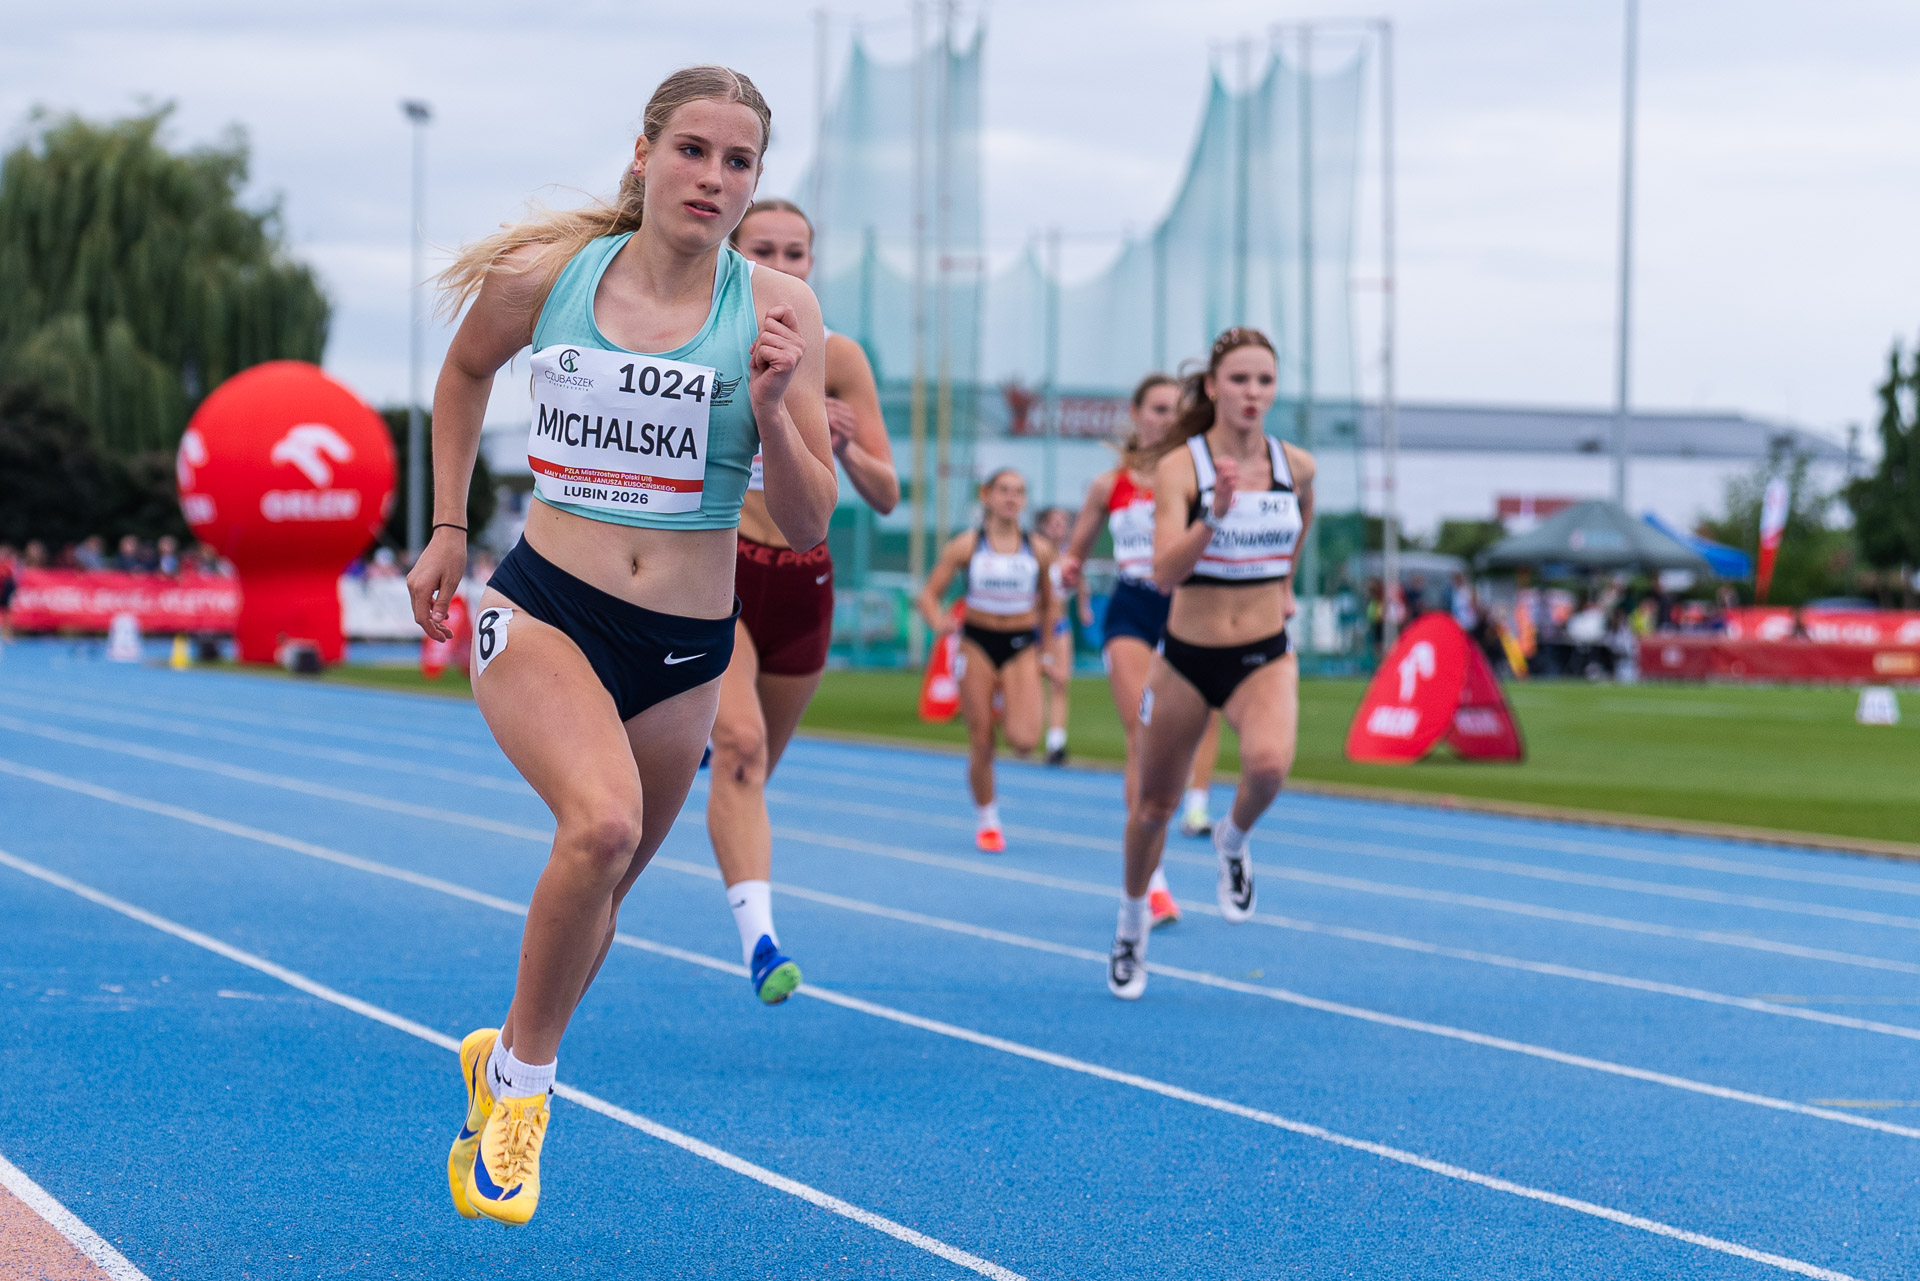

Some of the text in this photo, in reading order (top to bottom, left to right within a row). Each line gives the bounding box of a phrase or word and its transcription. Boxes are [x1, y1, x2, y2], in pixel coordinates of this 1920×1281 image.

[544, 370, 594, 388] CZUBASZEK
[618, 363, 706, 403] 1024
[536, 403, 698, 460] MICHALSKA
[564, 467, 580, 475] PZLA
[580, 469, 620, 479] Mistrzostwa
[620, 473, 641, 481] Polski
[593, 477, 622, 486] JANUSZA
[623, 480, 677, 492] KUSOCIŃSKIEGO
[564, 486, 649, 505] LUBIN 2026
[479, 610, 500, 661] 8
